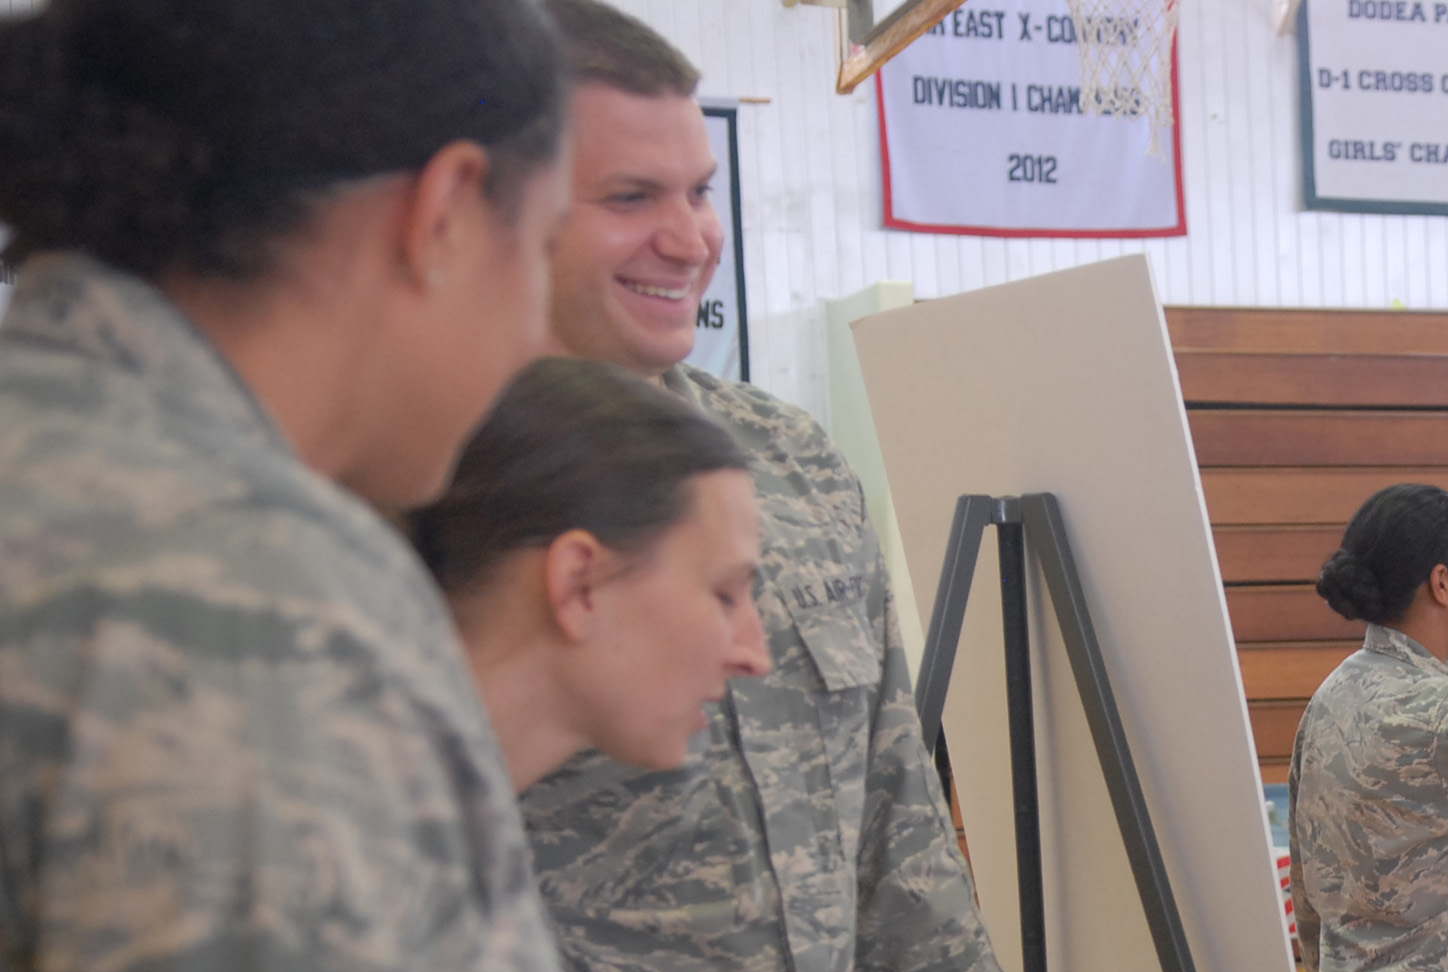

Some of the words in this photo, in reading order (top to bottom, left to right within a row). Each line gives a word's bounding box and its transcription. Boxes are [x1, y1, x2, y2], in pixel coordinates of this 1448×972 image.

[953, 9, 1005, 39] EAST
[1348, 0, 1427, 23] DODEA
[913, 75, 1001, 110] DIVISION
[1317, 67, 1351, 90] D-1
[1358, 70, 1434, 93] CROSS
[1328, 139, 1402, 162] GIRLS'
[1008, 153, 1058, 184] 2012
